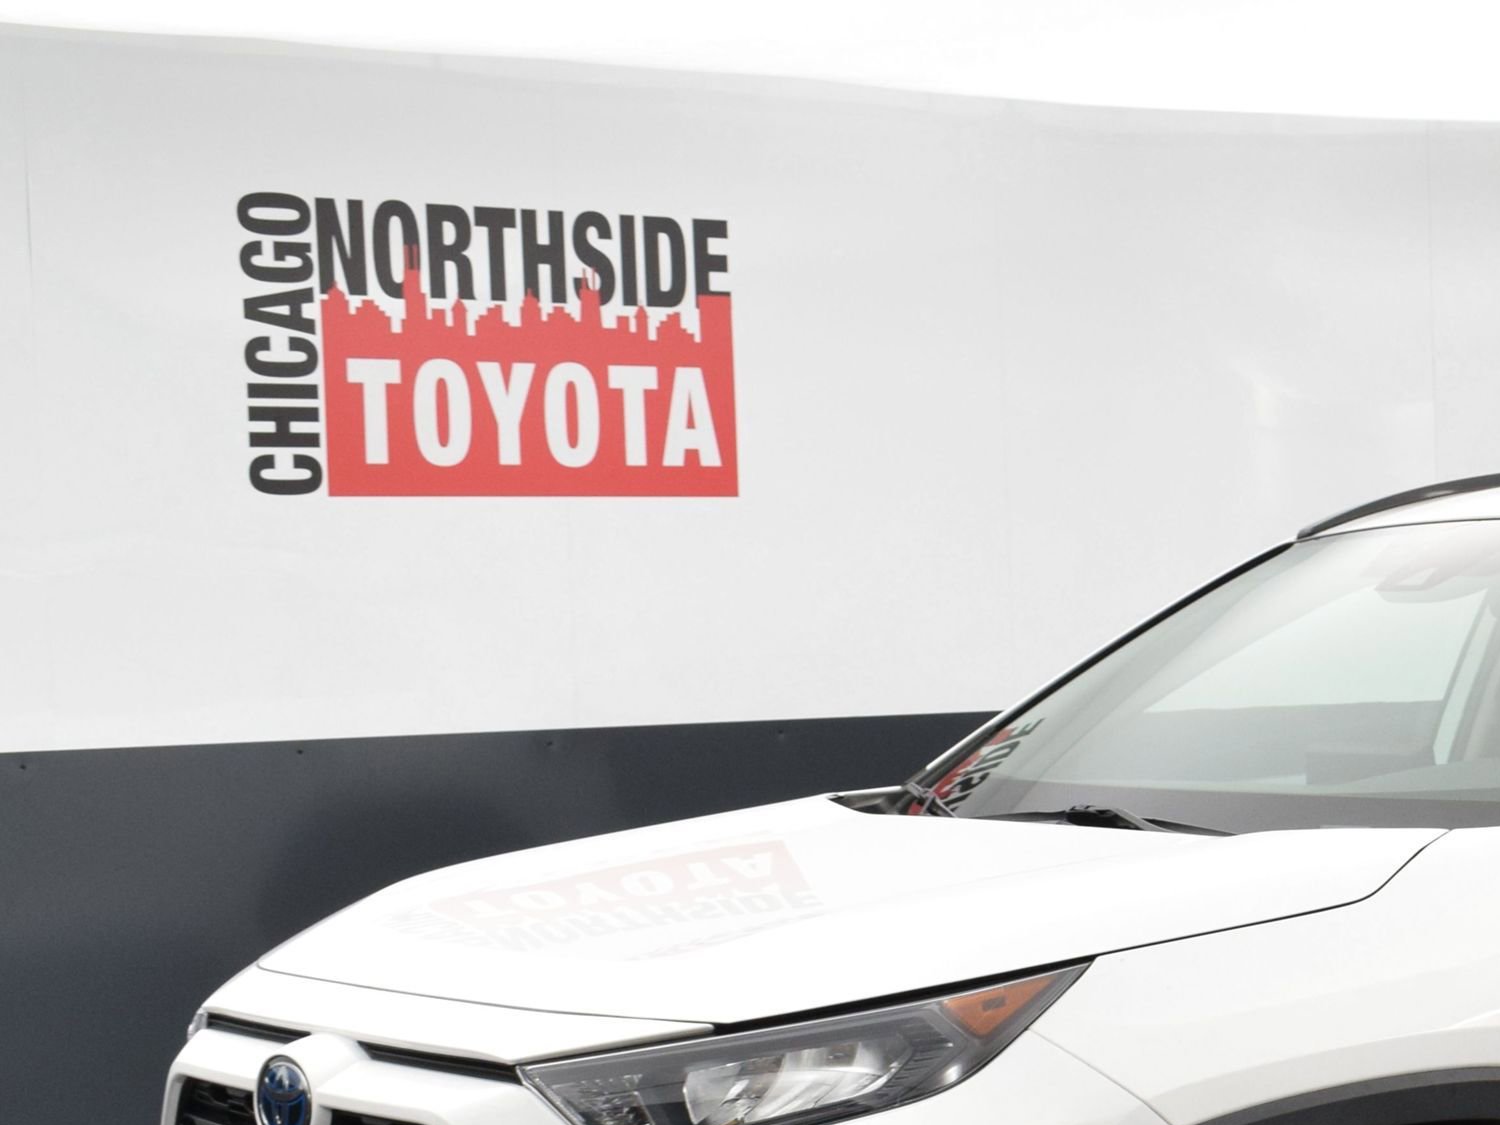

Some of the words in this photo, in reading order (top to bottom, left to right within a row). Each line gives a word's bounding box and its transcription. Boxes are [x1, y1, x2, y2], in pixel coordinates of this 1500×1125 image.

[315, 197, 731, 308] NORTHSIDE
[237, 192, 323, 496] CHICAGO
[346, 358, 722, 468] TOYOTA
